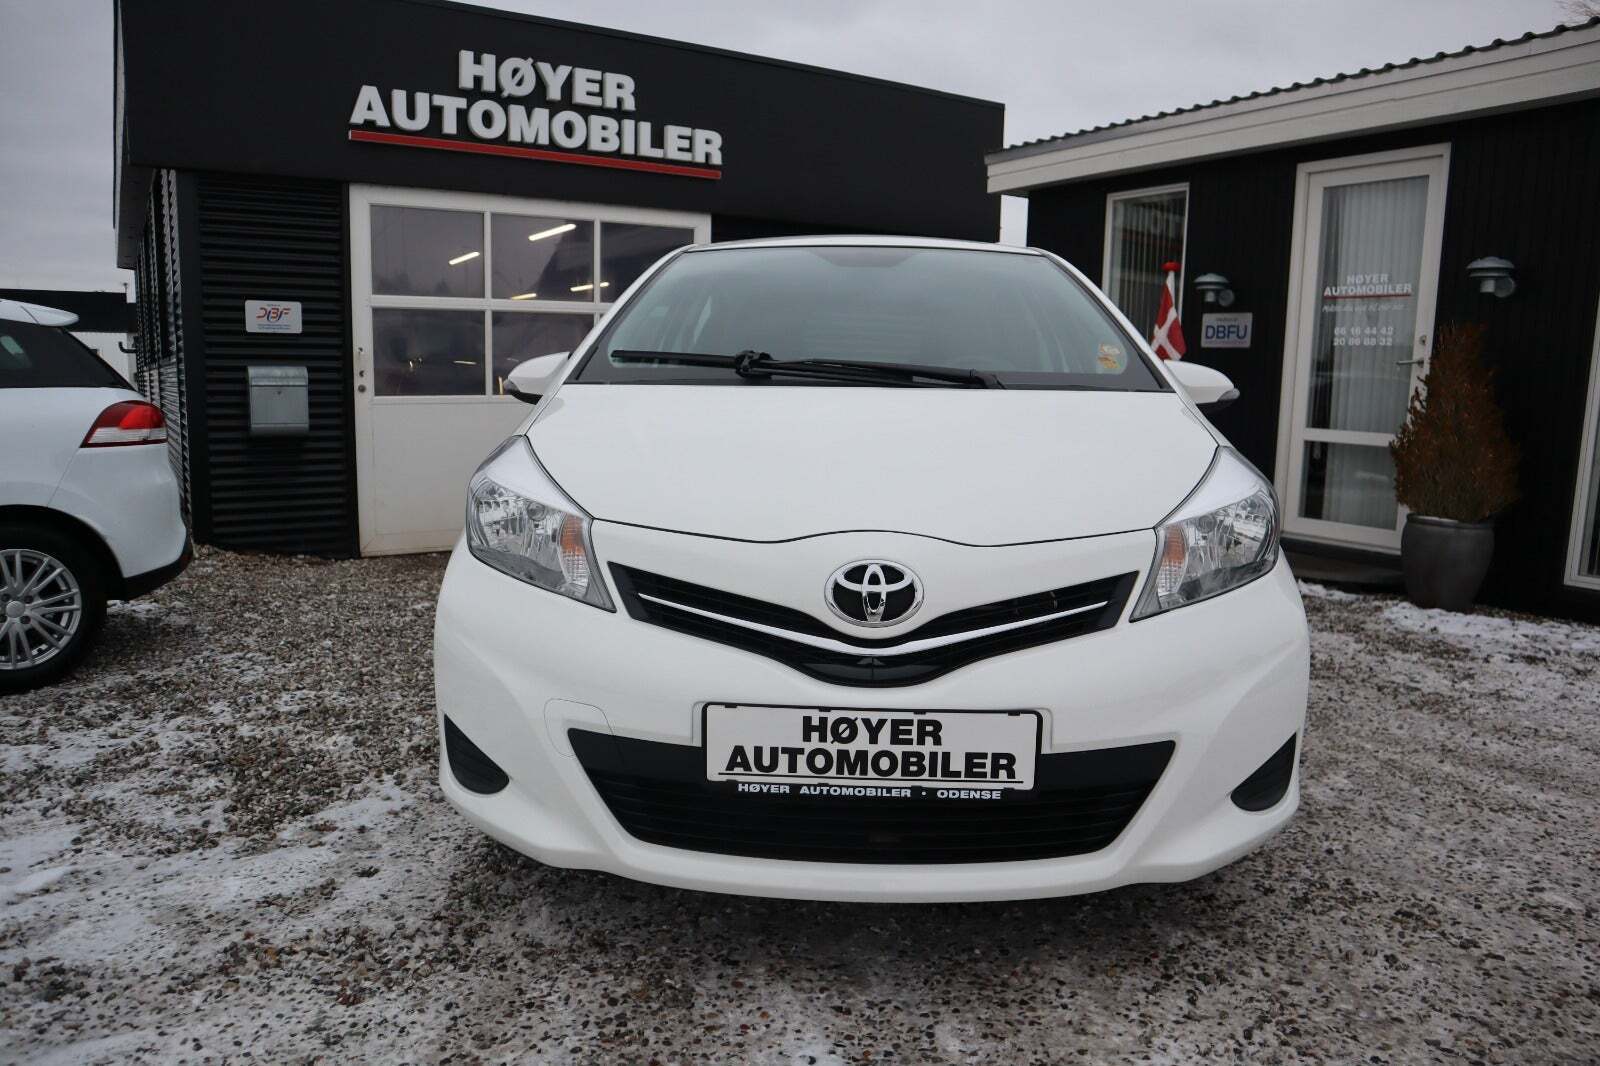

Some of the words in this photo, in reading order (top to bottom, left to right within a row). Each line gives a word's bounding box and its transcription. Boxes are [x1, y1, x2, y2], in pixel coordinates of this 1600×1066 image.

[458, 49, 637, 112] HØYER
[349, 84, 723, 165] AUTOMOBILER
[1323, 283, 1412, 297] AUTOMOBILER
[1204, 324, 1248, 340] DBFU
[802, 715, 943, 746] HØYER
[724, 745, 1017, 780] AUTOMOBILER
[737, 782, 791, 794] HØYER
[799, 785, 911, 798] AUTOMOBILER
[936, 789, 1002, 800] ODENSE
